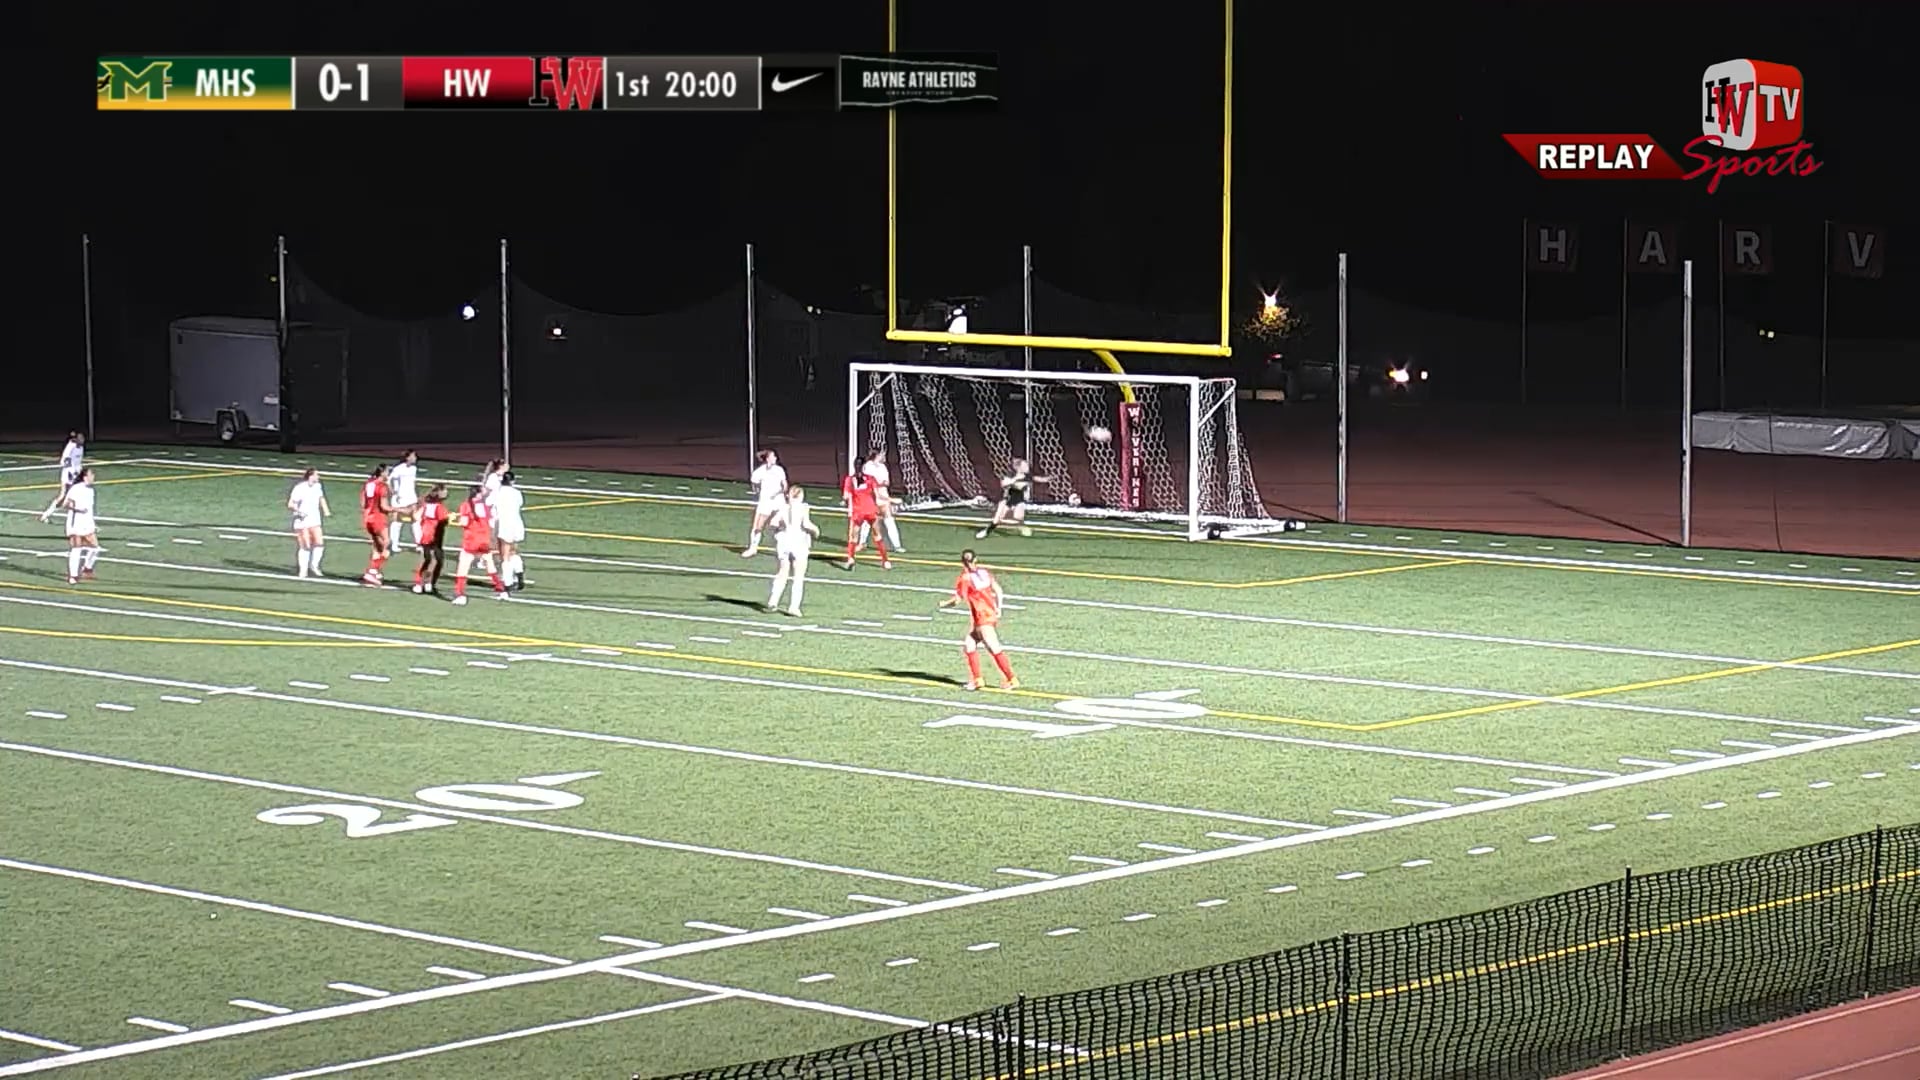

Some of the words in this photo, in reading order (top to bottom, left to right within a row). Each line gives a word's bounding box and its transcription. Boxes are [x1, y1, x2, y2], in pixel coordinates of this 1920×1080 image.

[1538, 229, 1567, 263] H
[1639, 231, 1667, 265] A
[1735, 231, 1762, 265] R
[1848, 232, 1875, 268] V
[922, 697, 1207, 740] 10
[256, 782, 585, 839] 20
